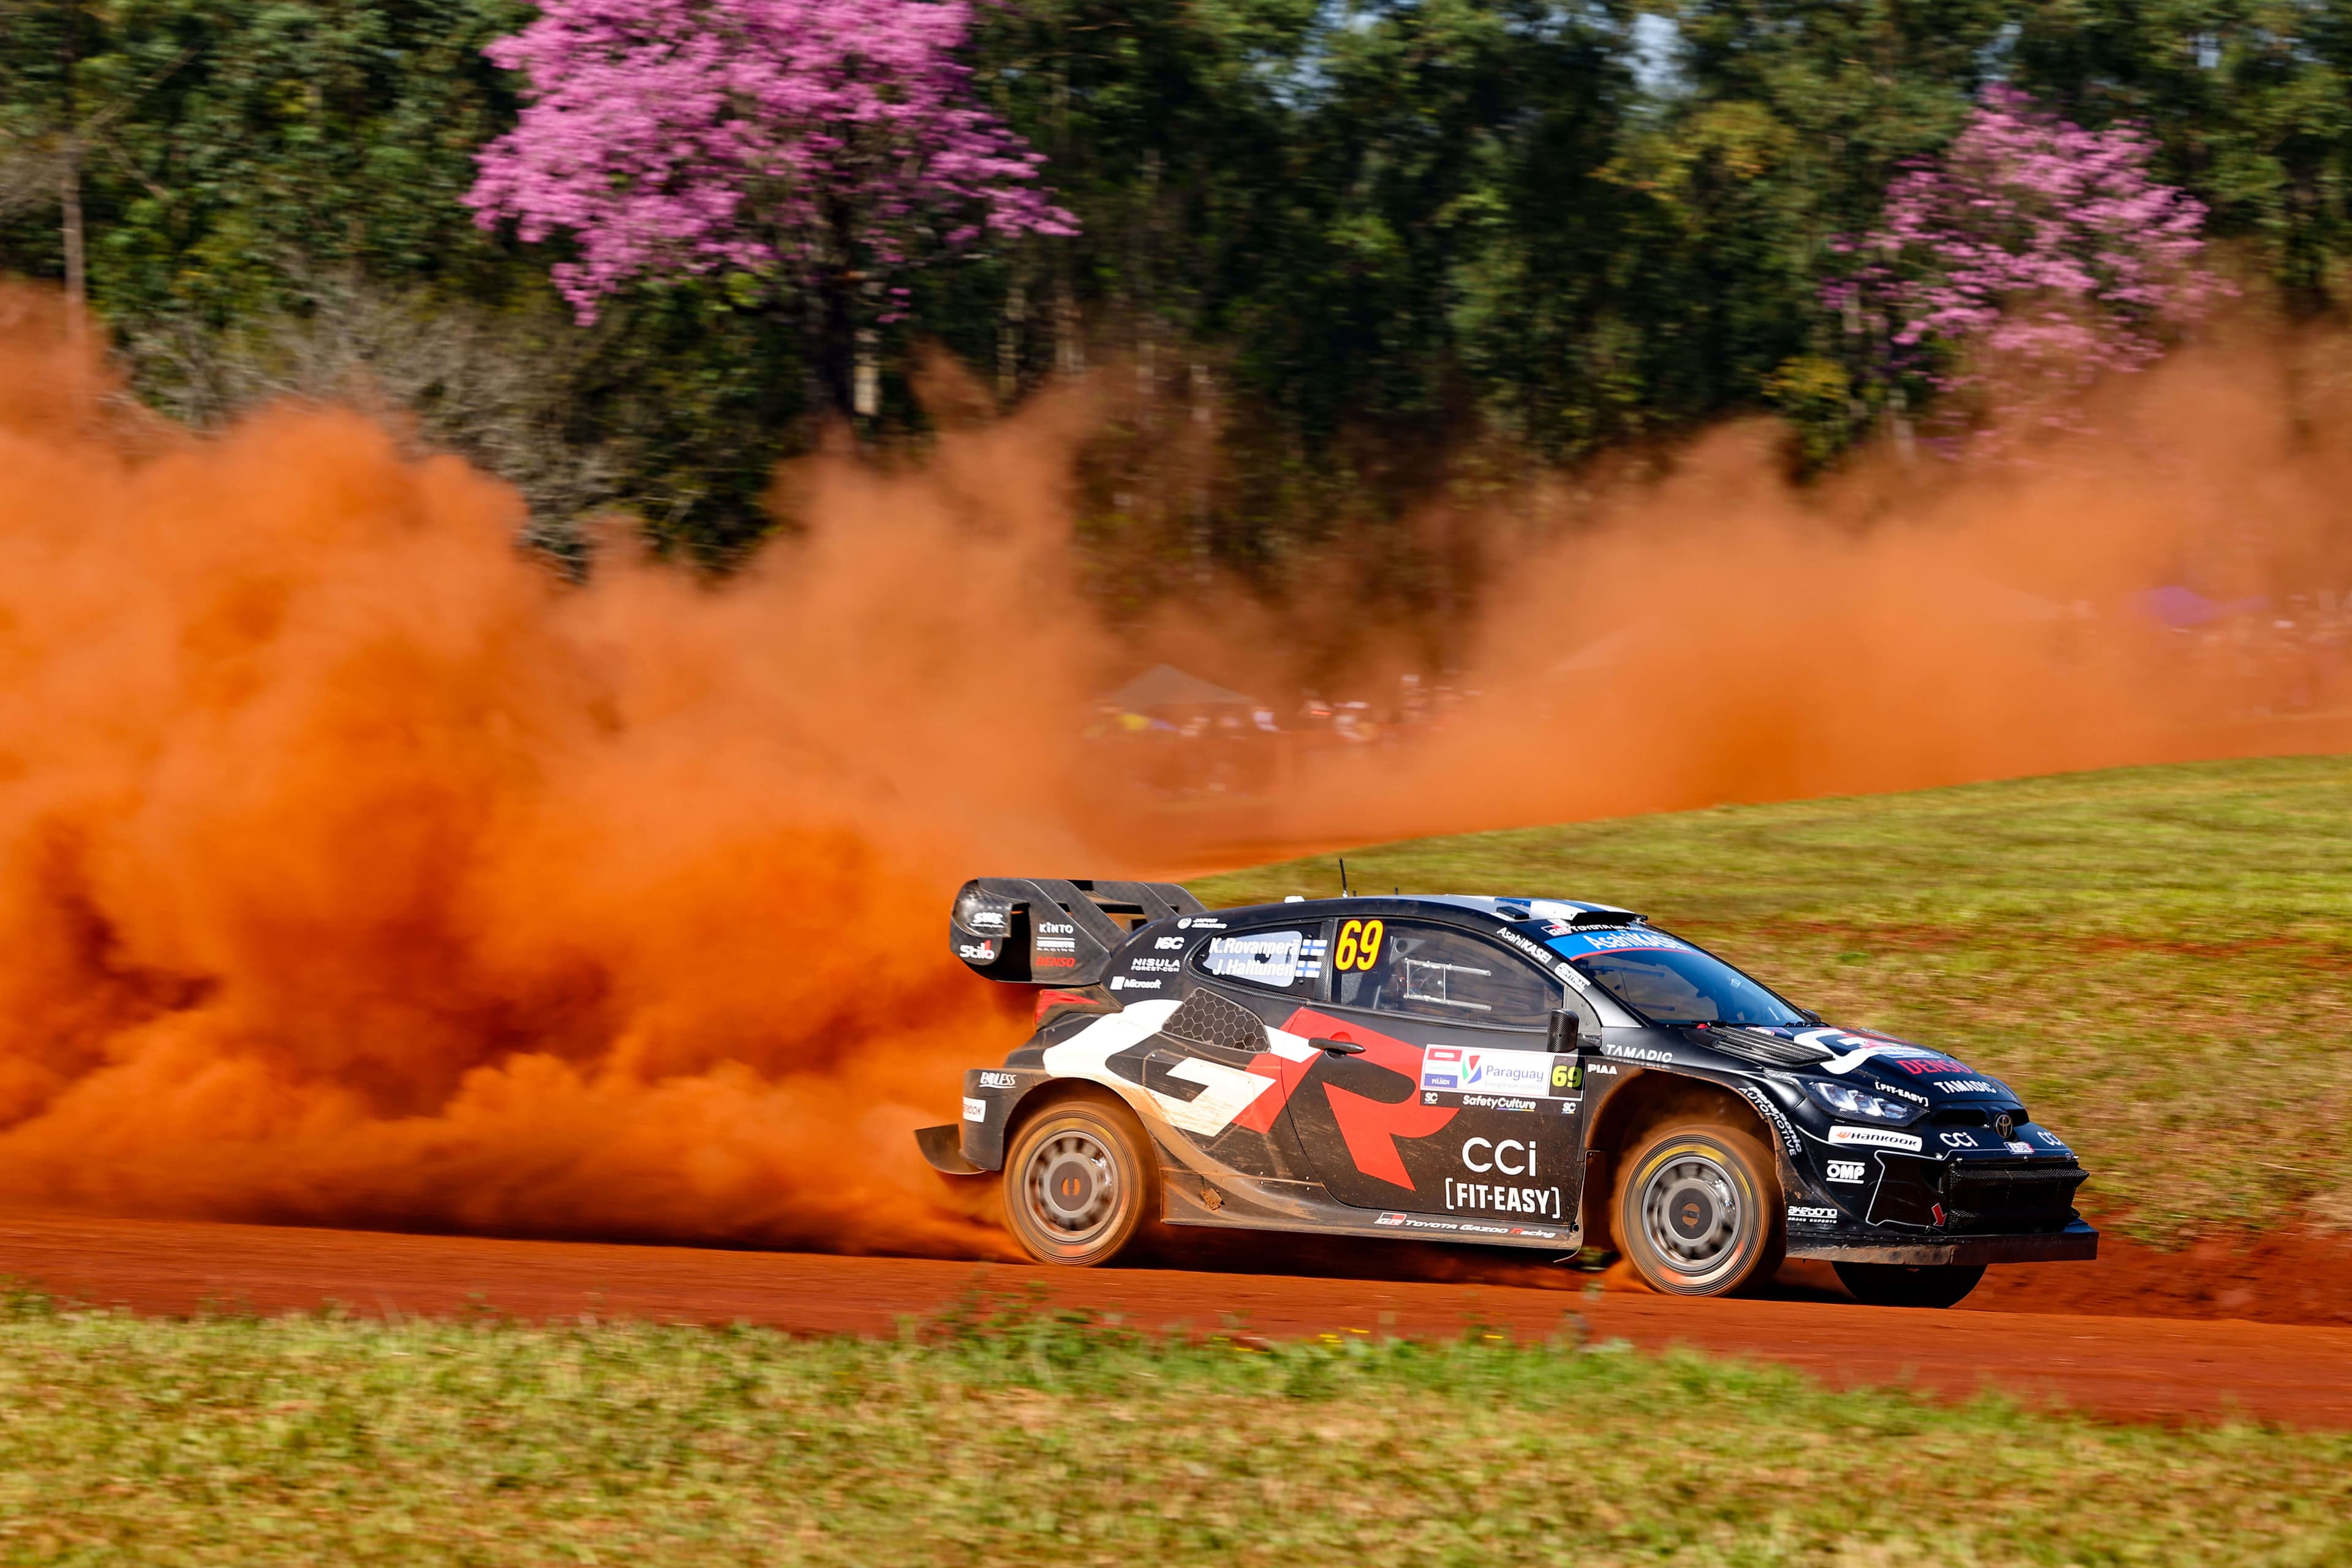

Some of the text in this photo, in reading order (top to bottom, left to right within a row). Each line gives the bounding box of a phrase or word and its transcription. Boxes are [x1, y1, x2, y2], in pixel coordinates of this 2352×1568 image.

[960, 940, 995, 960] Stilo
[1335, 919, 1384, 971] 69
[1496, 927, 1553, 964] AsahiKASEI
[1036, 956, 1076, 967] DENSO
[1132, 958, 1180, 967] NISULA
[1123, 979, 1161, 989] Microsoft
[1606, 1044, 1673, 1063] TAMADIC
[1486, 1065, 1544, 1082] Paraguay
[1587, 1063, 1618, 1074] PIAA
[1896, 1059, 1972, 1074] DENSO
[1551, 1065, 1583, 1088] 69
[1933, 1080, 1996, 1093] TAMADIC
[1424, 1092, 1438, 1102] SC
[1463, 1095, 1536, 1109] SafetyCulture
[1562, 1102, 1577, 1112] SC
[1738, 1087, 1797, 1156] AUTOMOTIVE
[1747, 1087, 1802, 1153] Panasonic
[1827, 1164, 1864, 1180] OMP
[1406, 1220, 1458, 1229] TOYOTA
[1460, 1224, 1509, 1233] GAZOO
